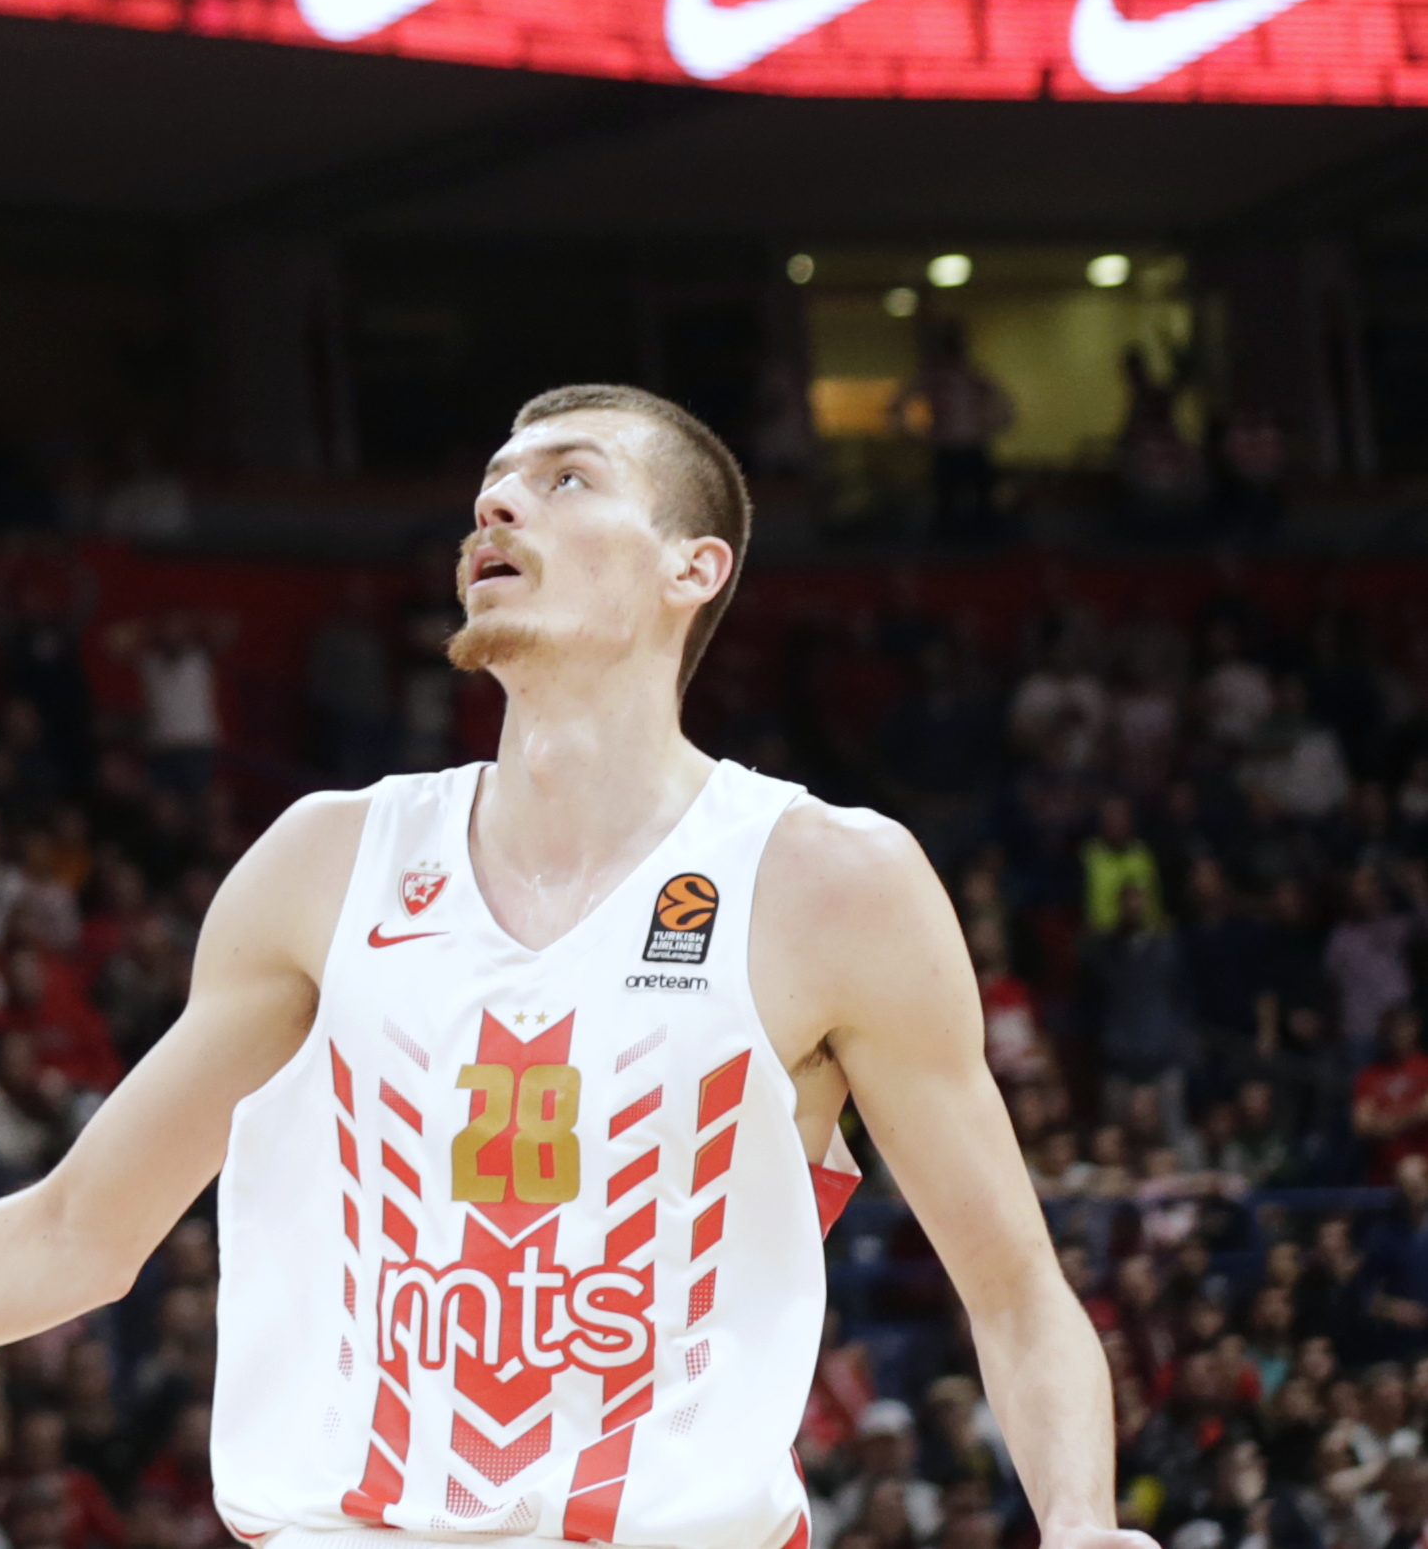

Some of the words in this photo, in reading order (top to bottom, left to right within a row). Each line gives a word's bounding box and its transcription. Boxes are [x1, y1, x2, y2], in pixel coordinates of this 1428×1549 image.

[653, 931, 706, 943] TURKISH
[650, 941, 703, 953] AIRLINES
[625, 973, 708, 990] oneteam
[451, 1064, 581, 1203] 28
[381, 1246, 648, 1368] mts
